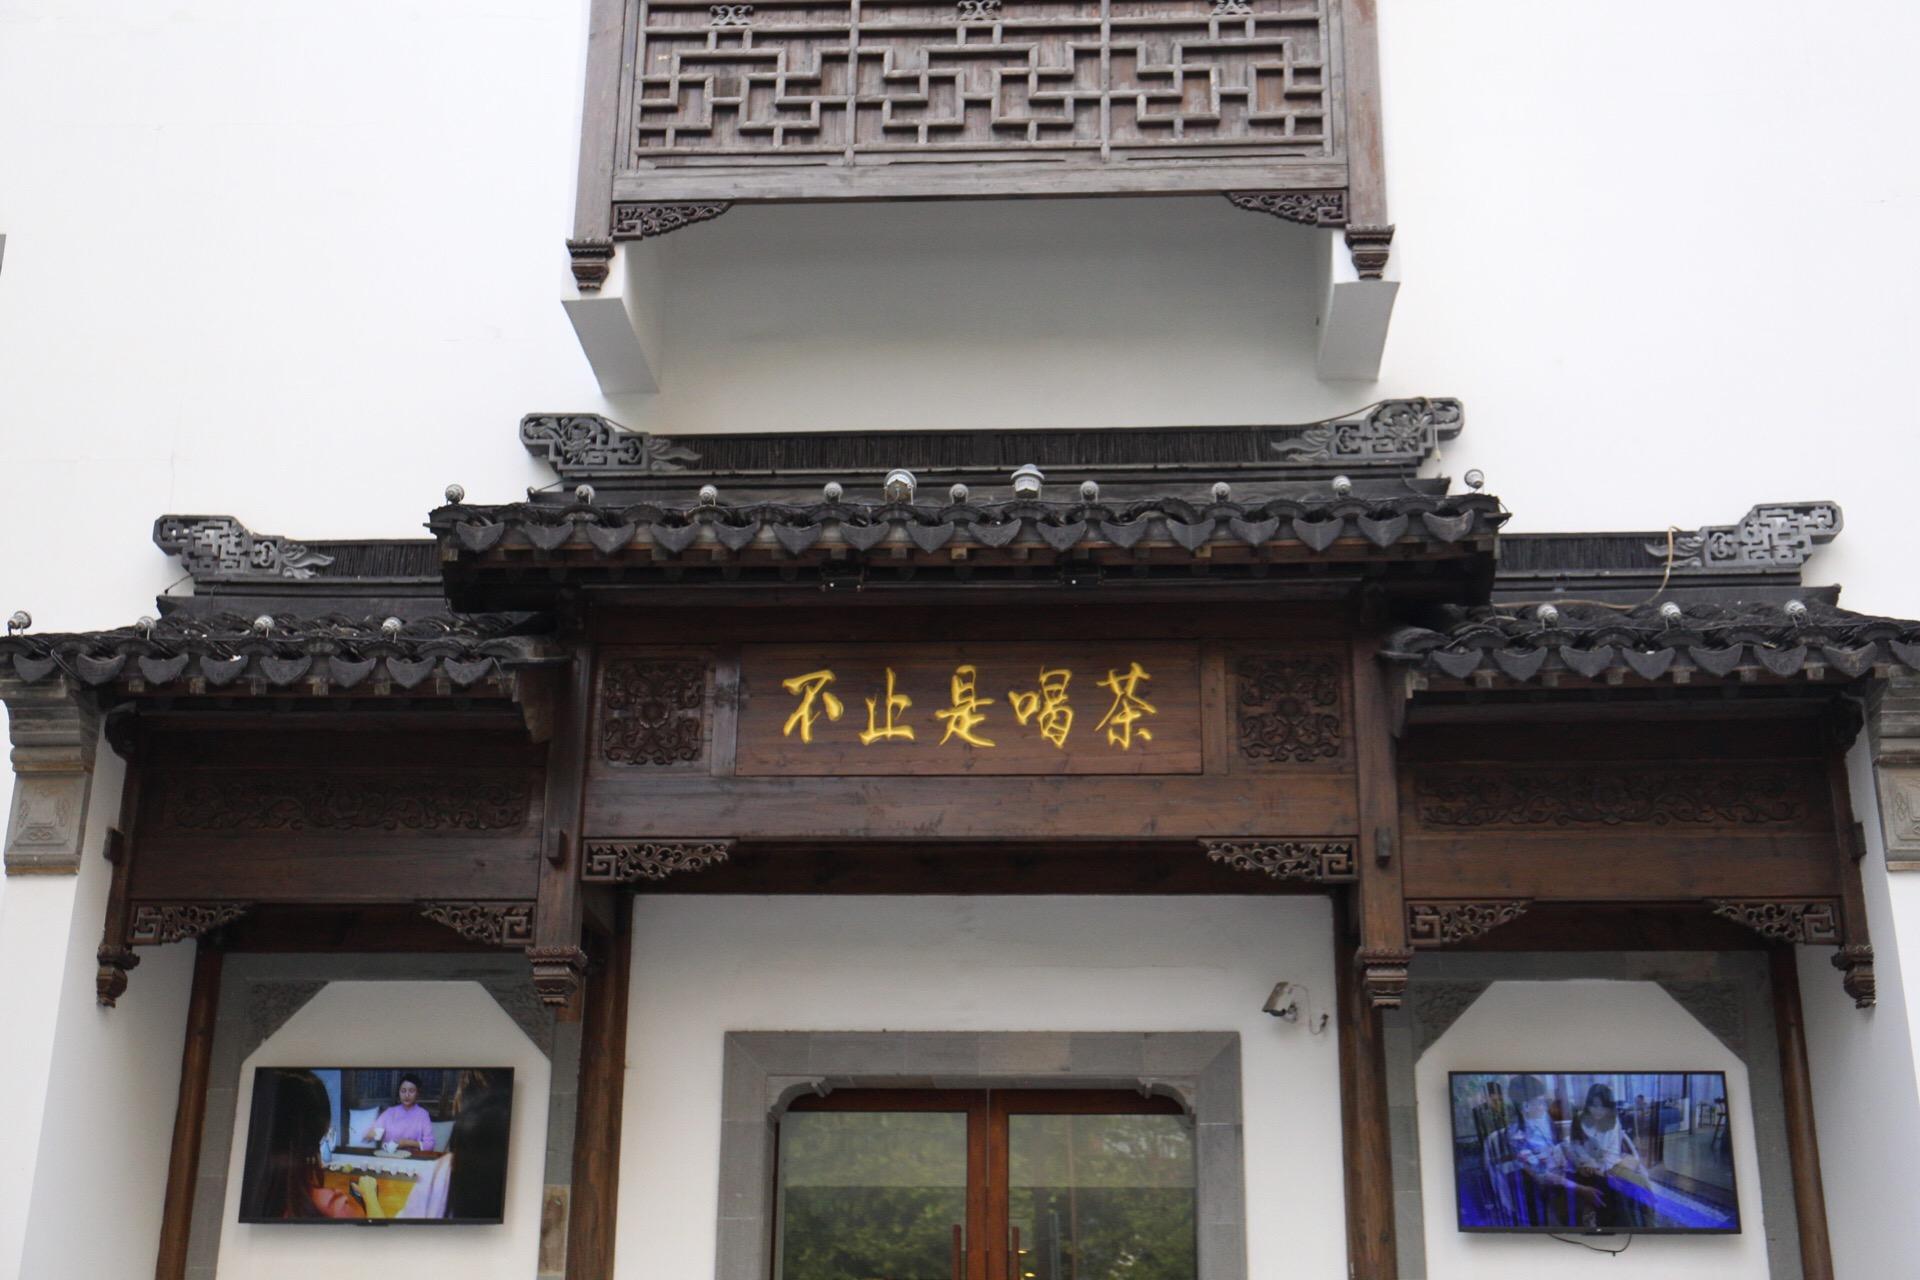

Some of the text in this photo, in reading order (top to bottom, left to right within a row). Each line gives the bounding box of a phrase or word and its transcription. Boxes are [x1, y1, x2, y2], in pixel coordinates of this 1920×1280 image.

[783, 662, 1157, 749] 不止是喝茶
